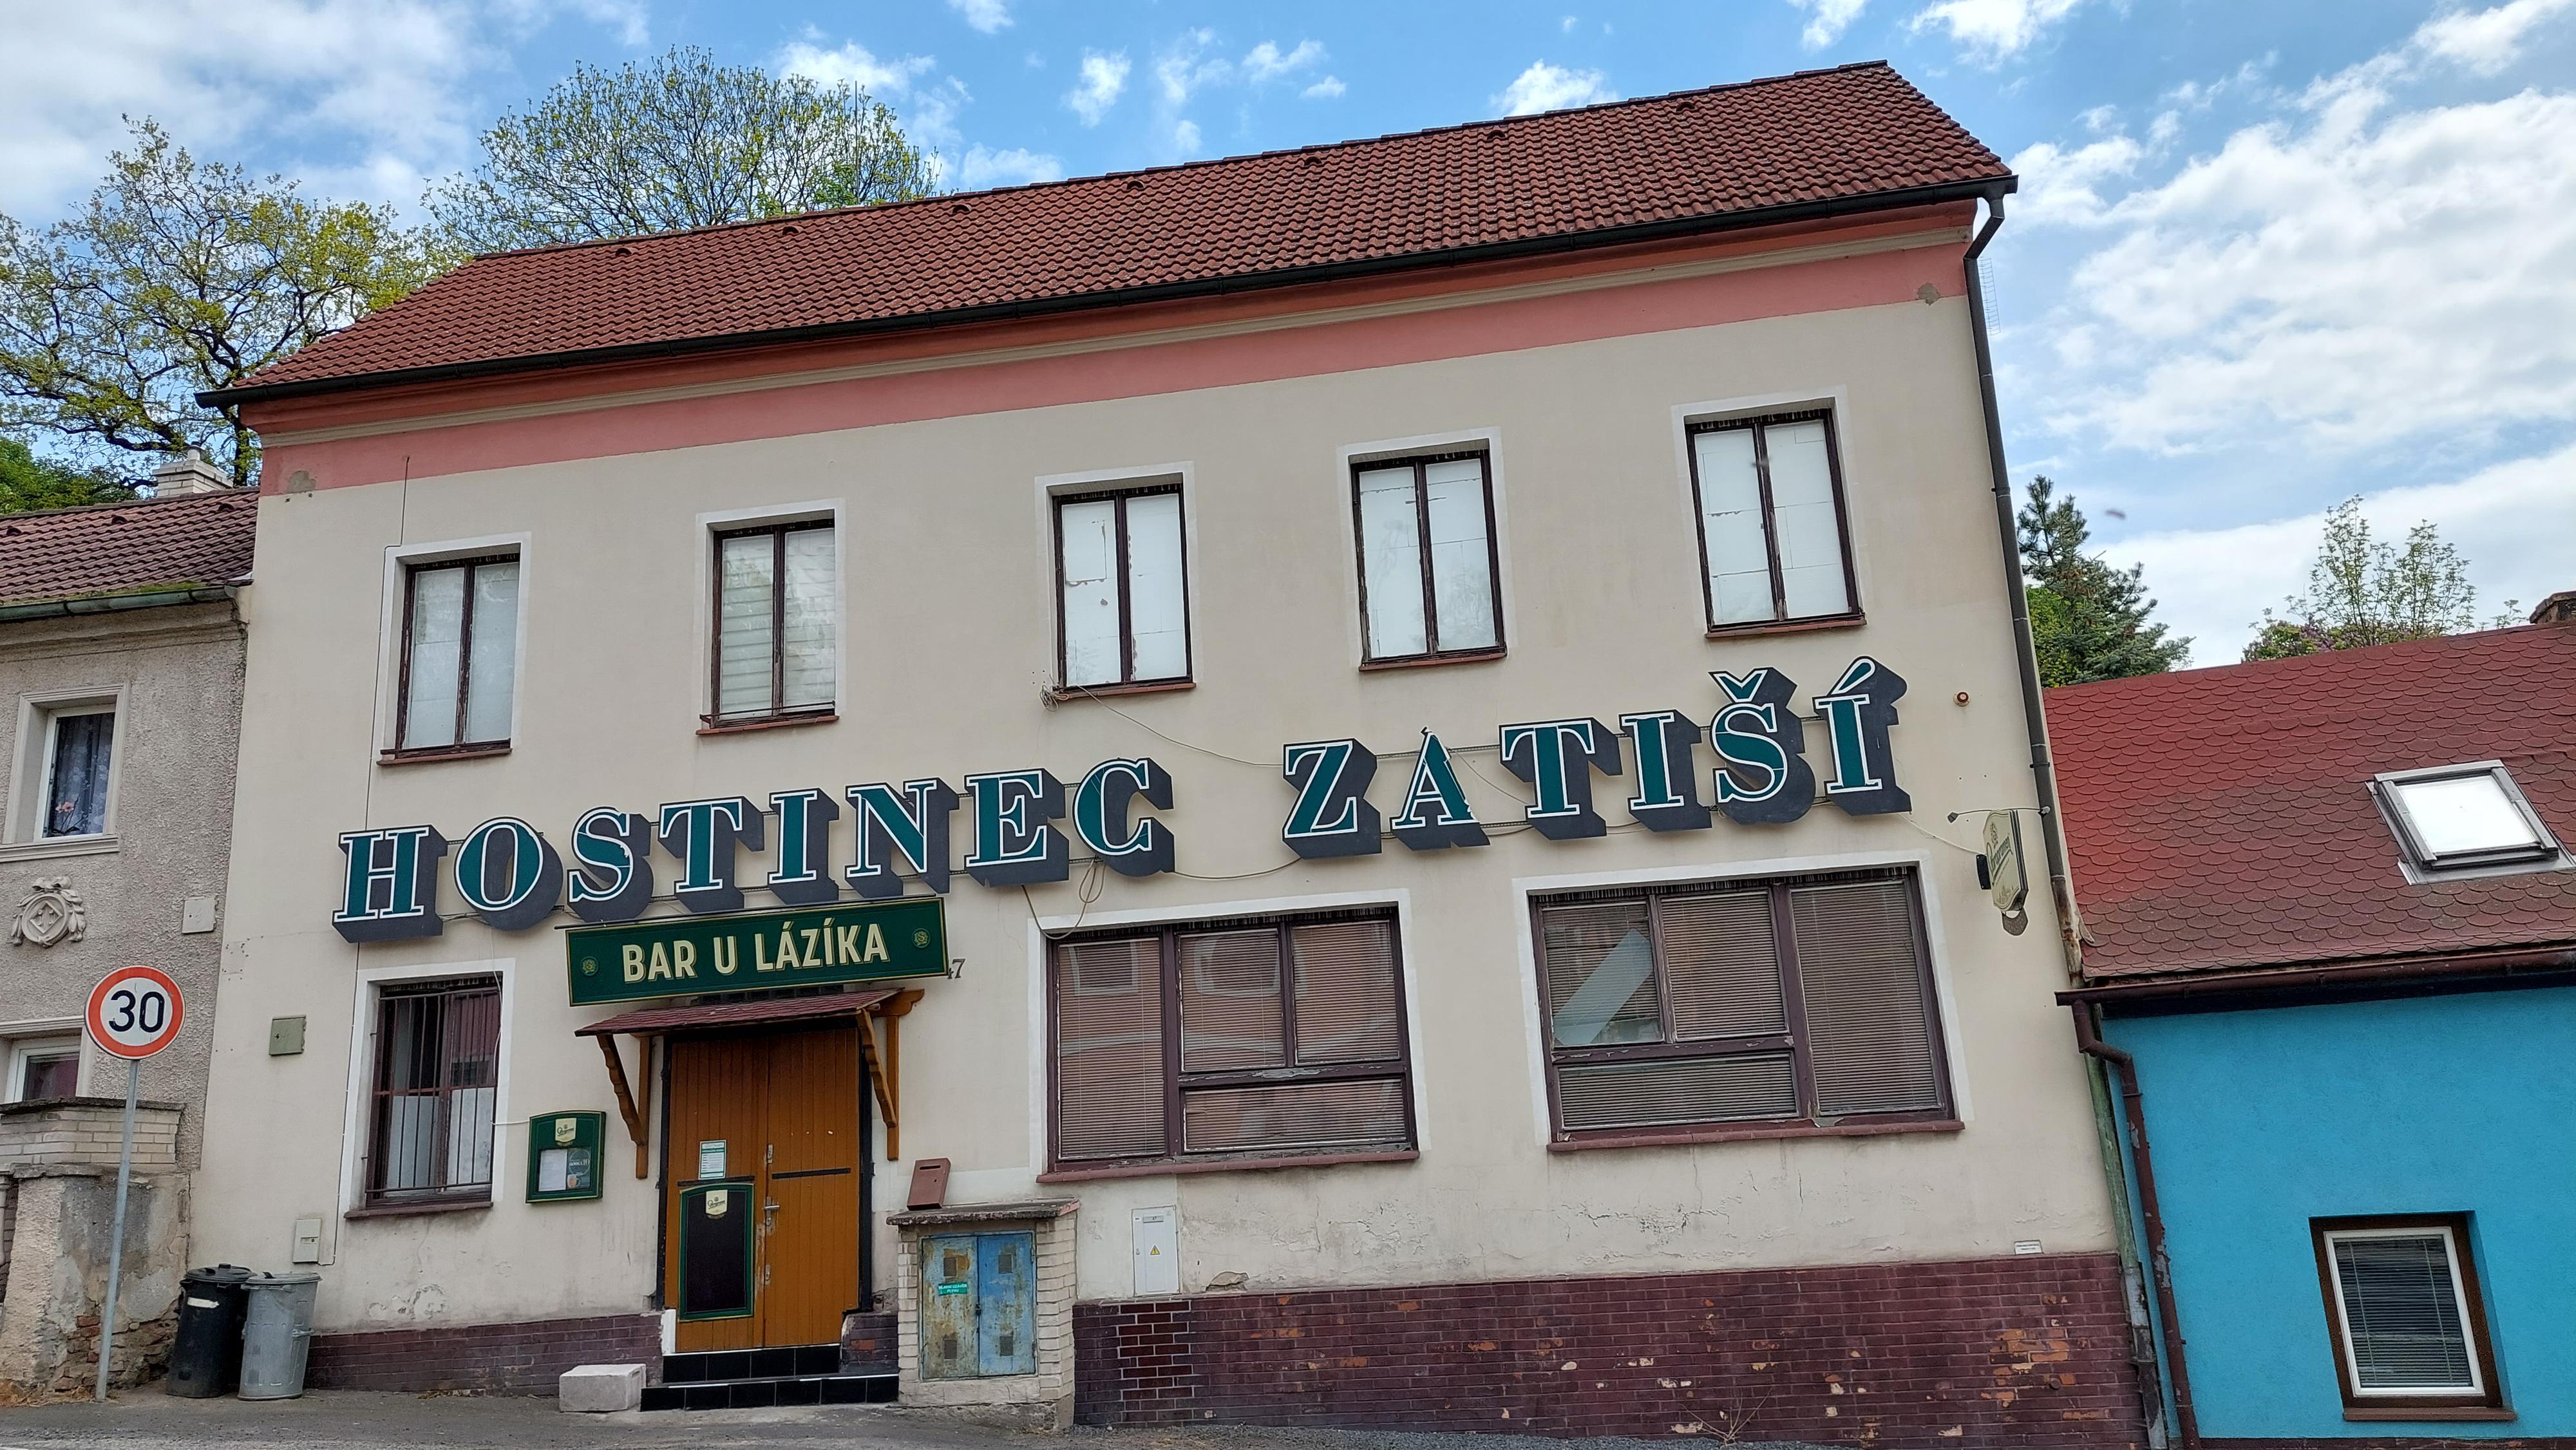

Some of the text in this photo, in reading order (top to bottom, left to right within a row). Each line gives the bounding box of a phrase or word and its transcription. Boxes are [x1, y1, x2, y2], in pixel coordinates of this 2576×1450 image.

[331, 655, 1897, 934] HOSTINEC ZATIŠÍ
[622, 917, 890, 984] BAR U LÁZÍKA
[108, 990, 166, 1033] 30
